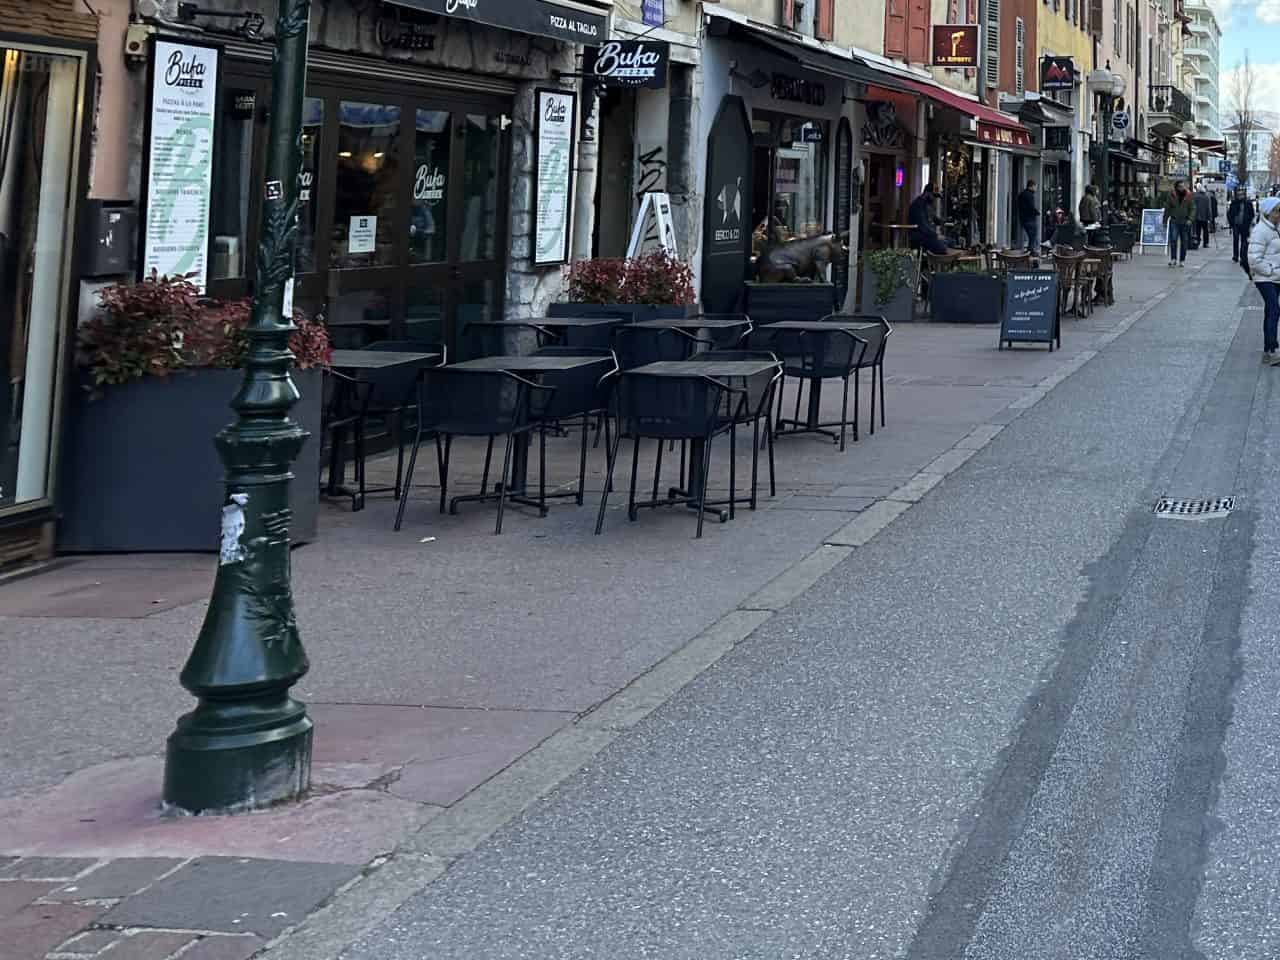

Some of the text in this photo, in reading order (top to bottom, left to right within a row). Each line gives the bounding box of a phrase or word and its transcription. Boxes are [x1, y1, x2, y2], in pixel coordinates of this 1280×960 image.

[550, 15, 598, 36] PIZZA AL TAGLIO
[165, 50, 206, 86] Bufa
[594, 42, 660, 75] Bufa
[545, 97, 567, 122] Bufa
[413, 164, 446, 199] Bufa
